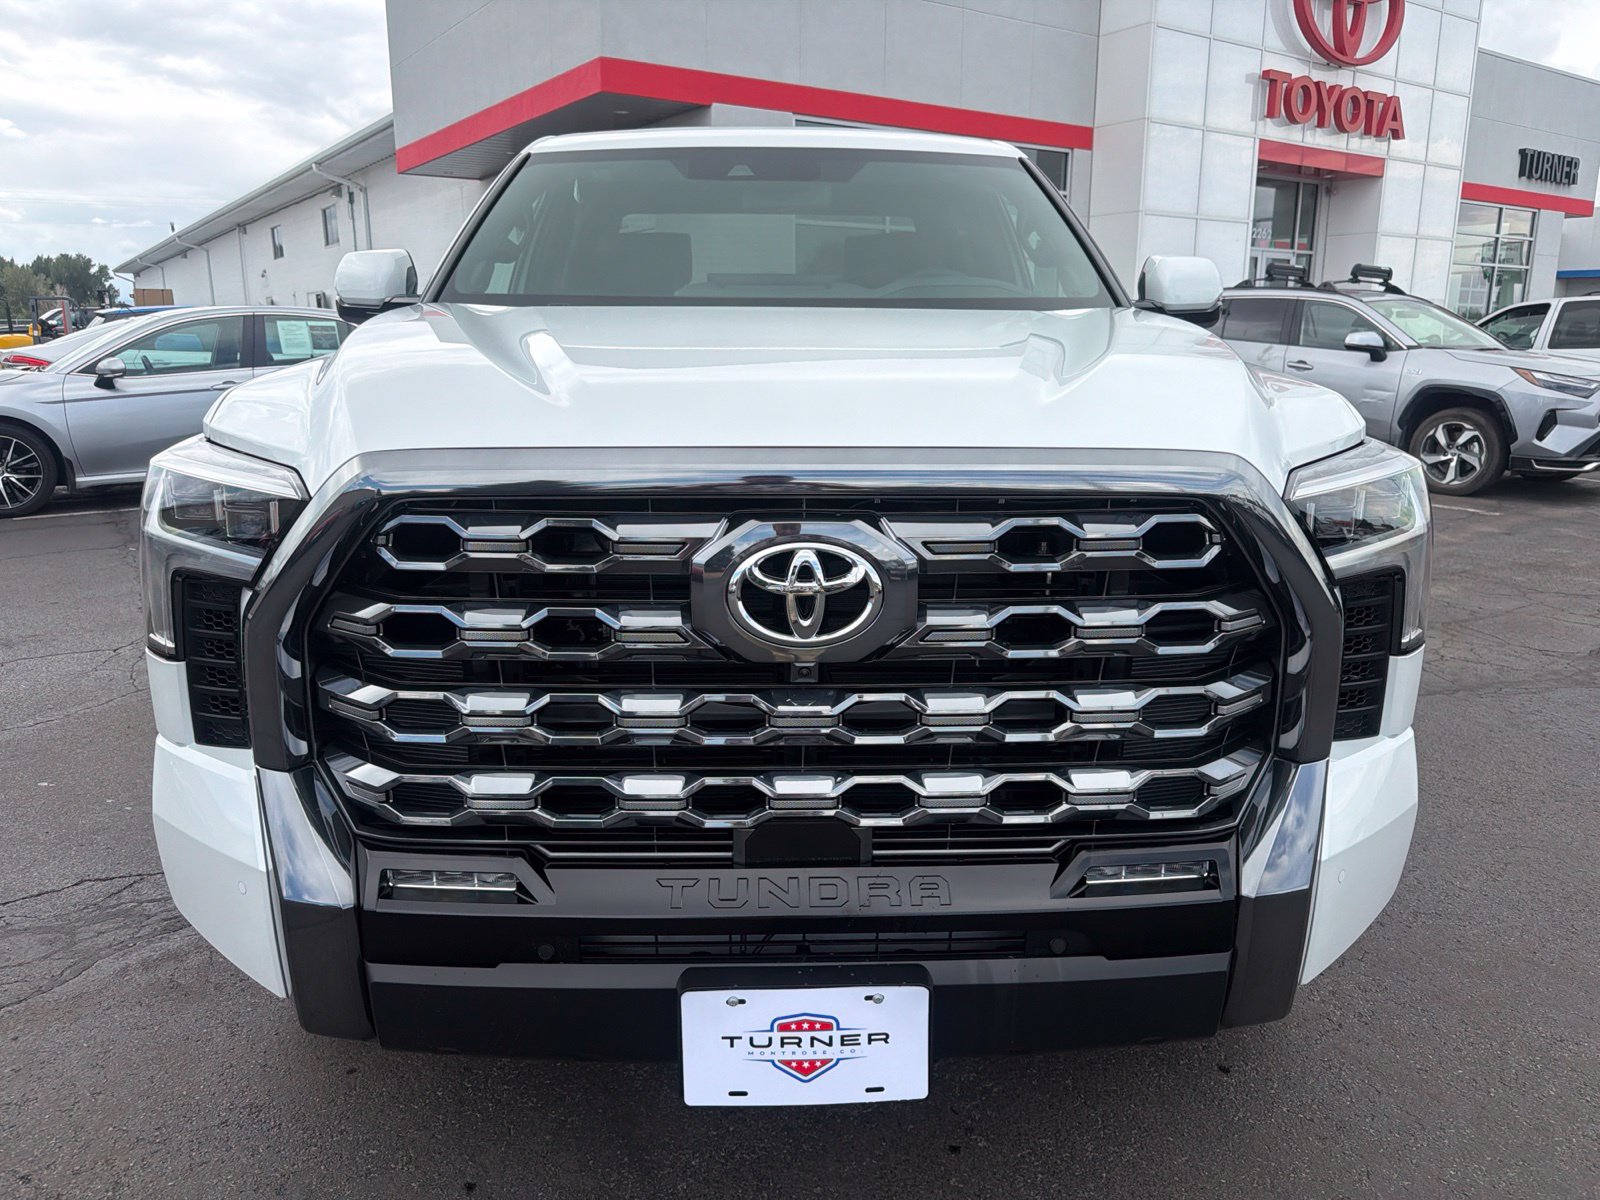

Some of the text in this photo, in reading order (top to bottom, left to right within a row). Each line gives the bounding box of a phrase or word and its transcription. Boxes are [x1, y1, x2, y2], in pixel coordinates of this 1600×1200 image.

[1262, 69, 1405, 140] TOYOTA
[1519, 148, 1580, 186] TURNER
[656, 874, 952, 909] TUNDRA
[721, 1032, 890, 1048] TURNER
